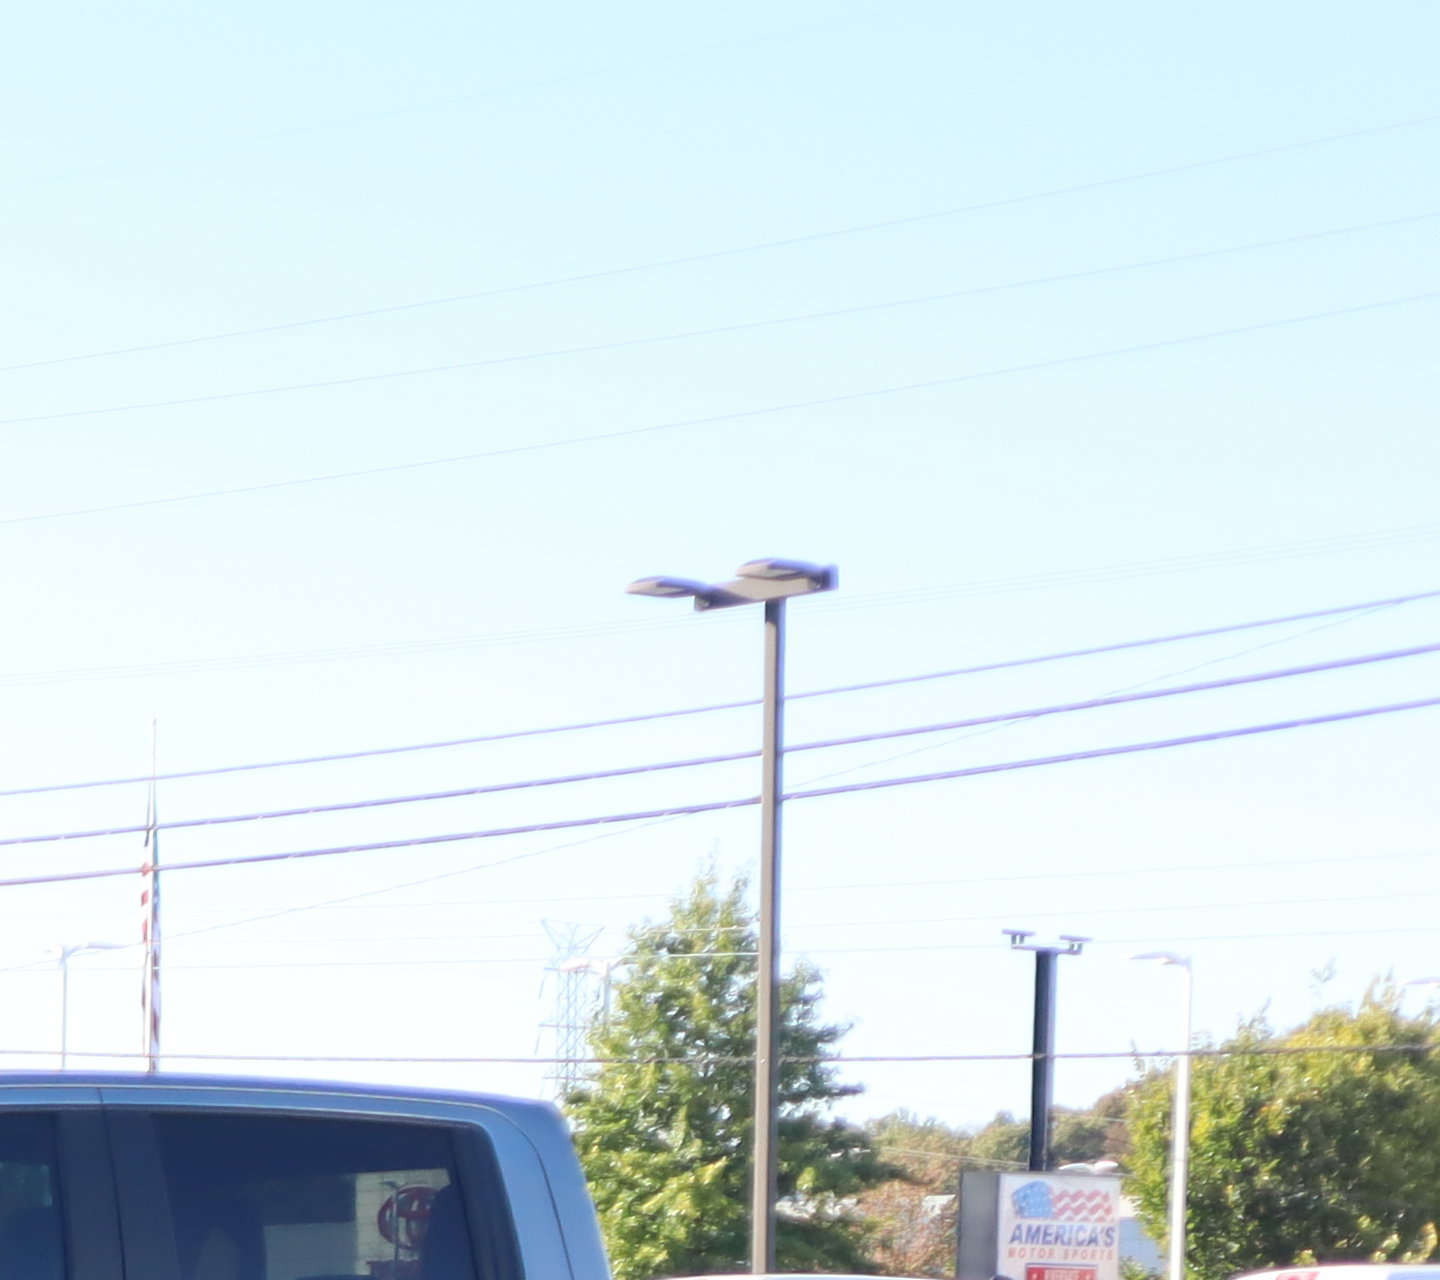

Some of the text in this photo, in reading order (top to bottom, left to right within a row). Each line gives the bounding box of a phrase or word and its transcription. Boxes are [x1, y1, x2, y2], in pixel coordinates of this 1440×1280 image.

[1009, 1223, 1115, 1247] AMERICA'S
[1008, 1247, 1114, 1260] MOTOR SPORTS
